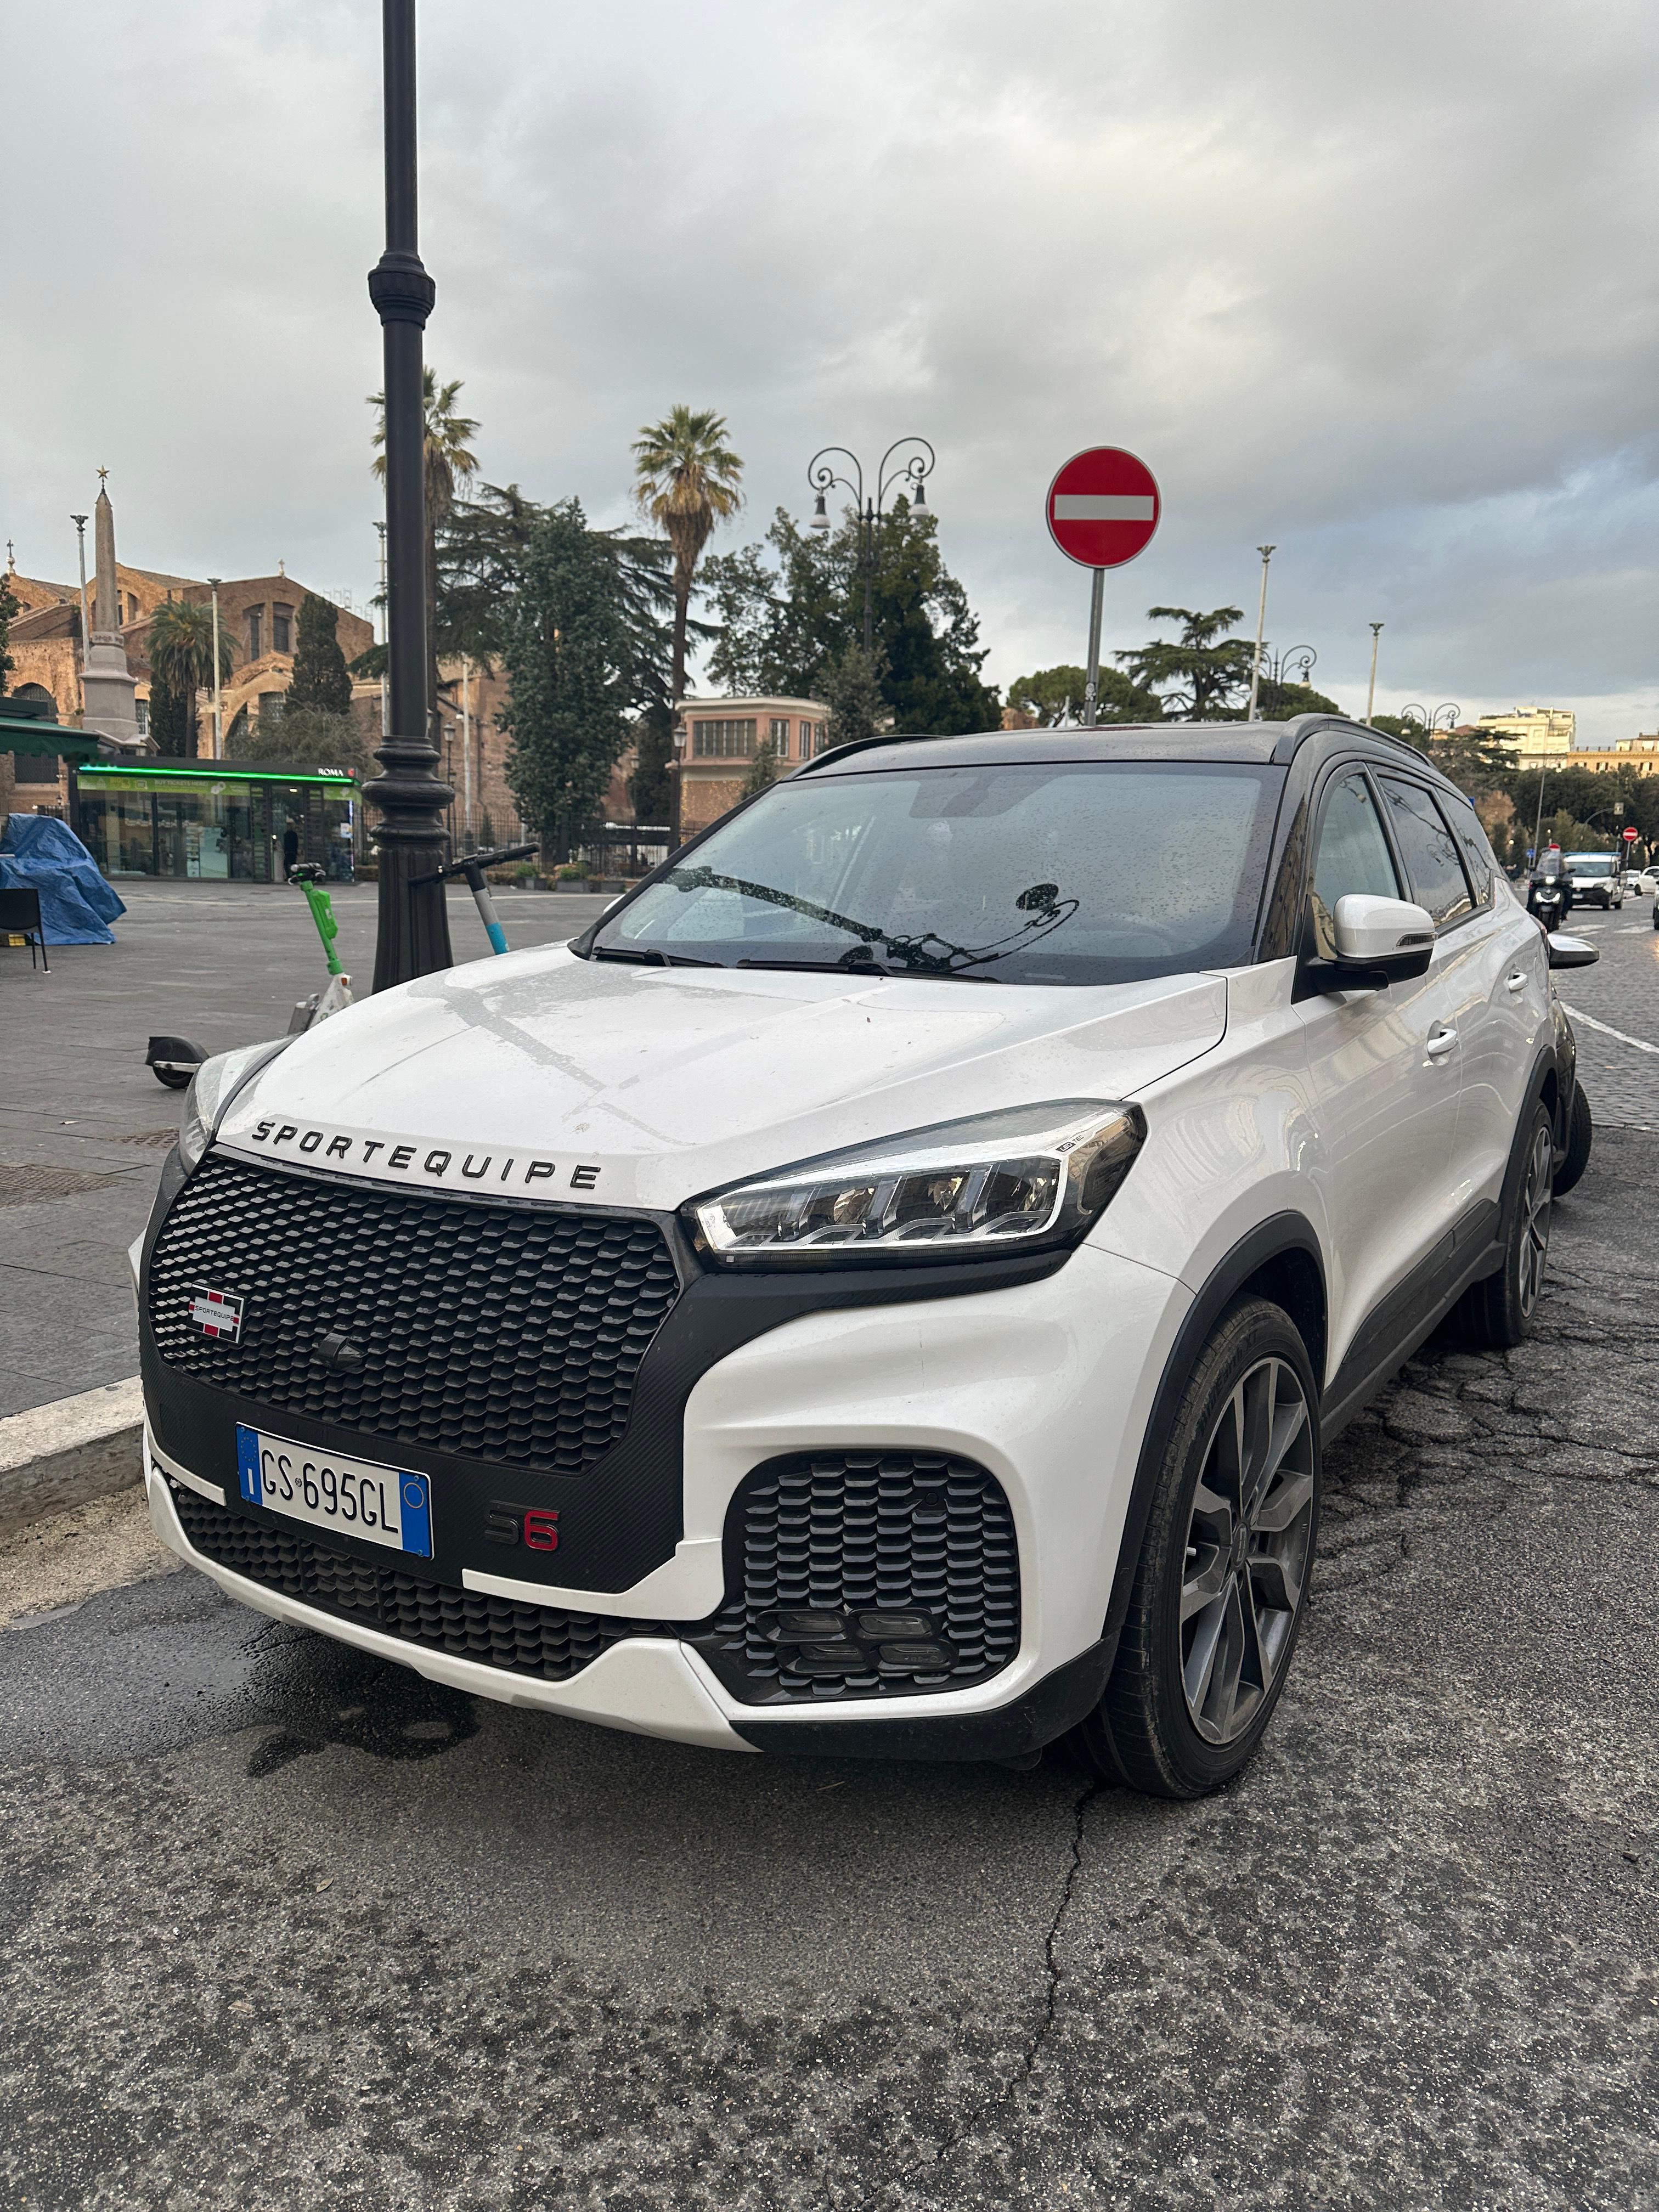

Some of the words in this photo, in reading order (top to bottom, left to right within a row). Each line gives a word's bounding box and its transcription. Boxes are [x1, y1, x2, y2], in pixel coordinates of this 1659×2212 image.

[318, 768, 343, 776] ROMA
[1059, 1142, 1073, 1152] LED
[252, 1121, 601, 1189] SPORTEQUIPE
[195, 1306, 234, 1321] SPORTEQUIPE
[485, 1500, 560, 1551] S6
